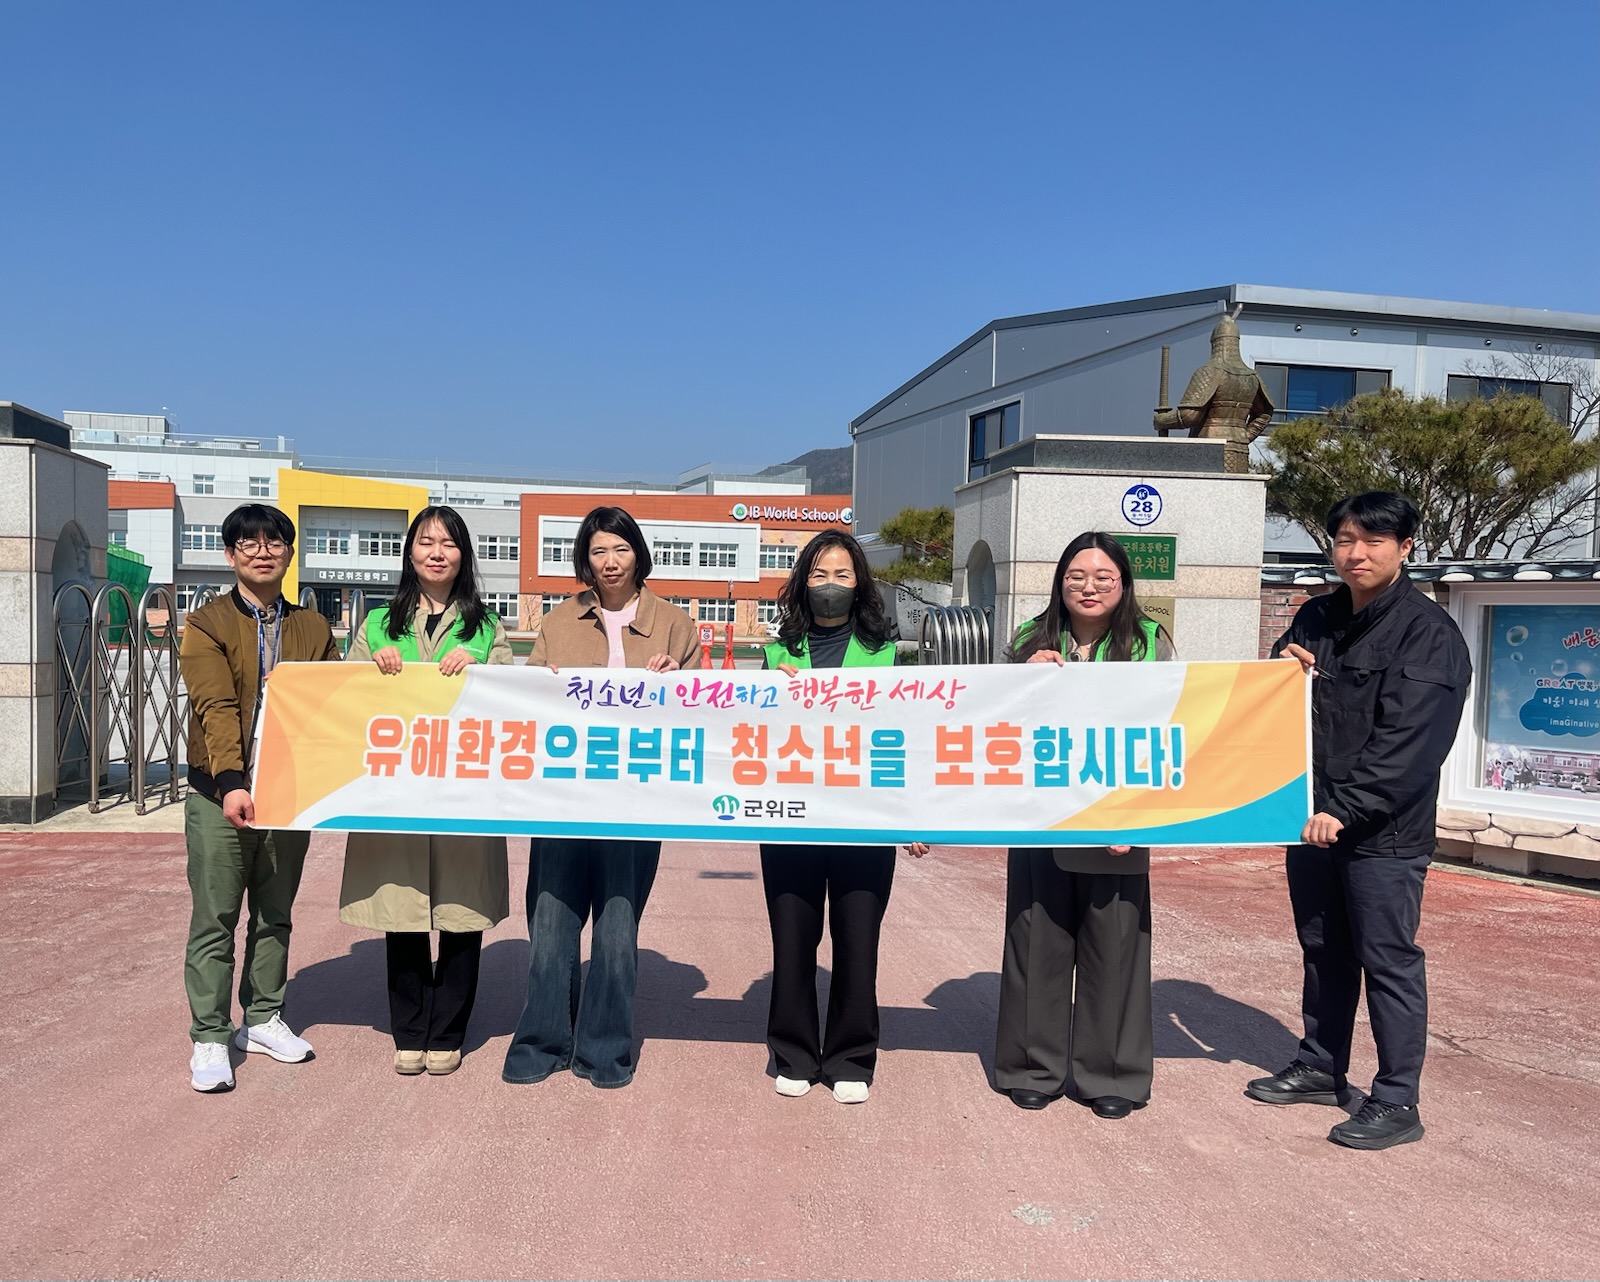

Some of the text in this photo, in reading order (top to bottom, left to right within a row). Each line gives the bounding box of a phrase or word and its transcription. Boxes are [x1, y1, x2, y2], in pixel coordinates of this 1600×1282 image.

[749, 505, 760, 519] IB
[763, 506, 798, 521] World
[801, 507, 839, 522] School
[1130, 500, 1153, 513] 28
[1128, 556, 1170, 573] 유치원
[319, 570, 389, 581] 대구군위초등학교
[1144, 605, 1170, 615] SCHOOL
[1563, 627, 1600, 649] 배움
[566, 675, 967, 712] 청소년이 안전하고 행복한 세상
[366, 717, 1182, 788] 유해환경으로부터 청소년을 보호합시다!
[743, 799, 807, 819] 군위군
